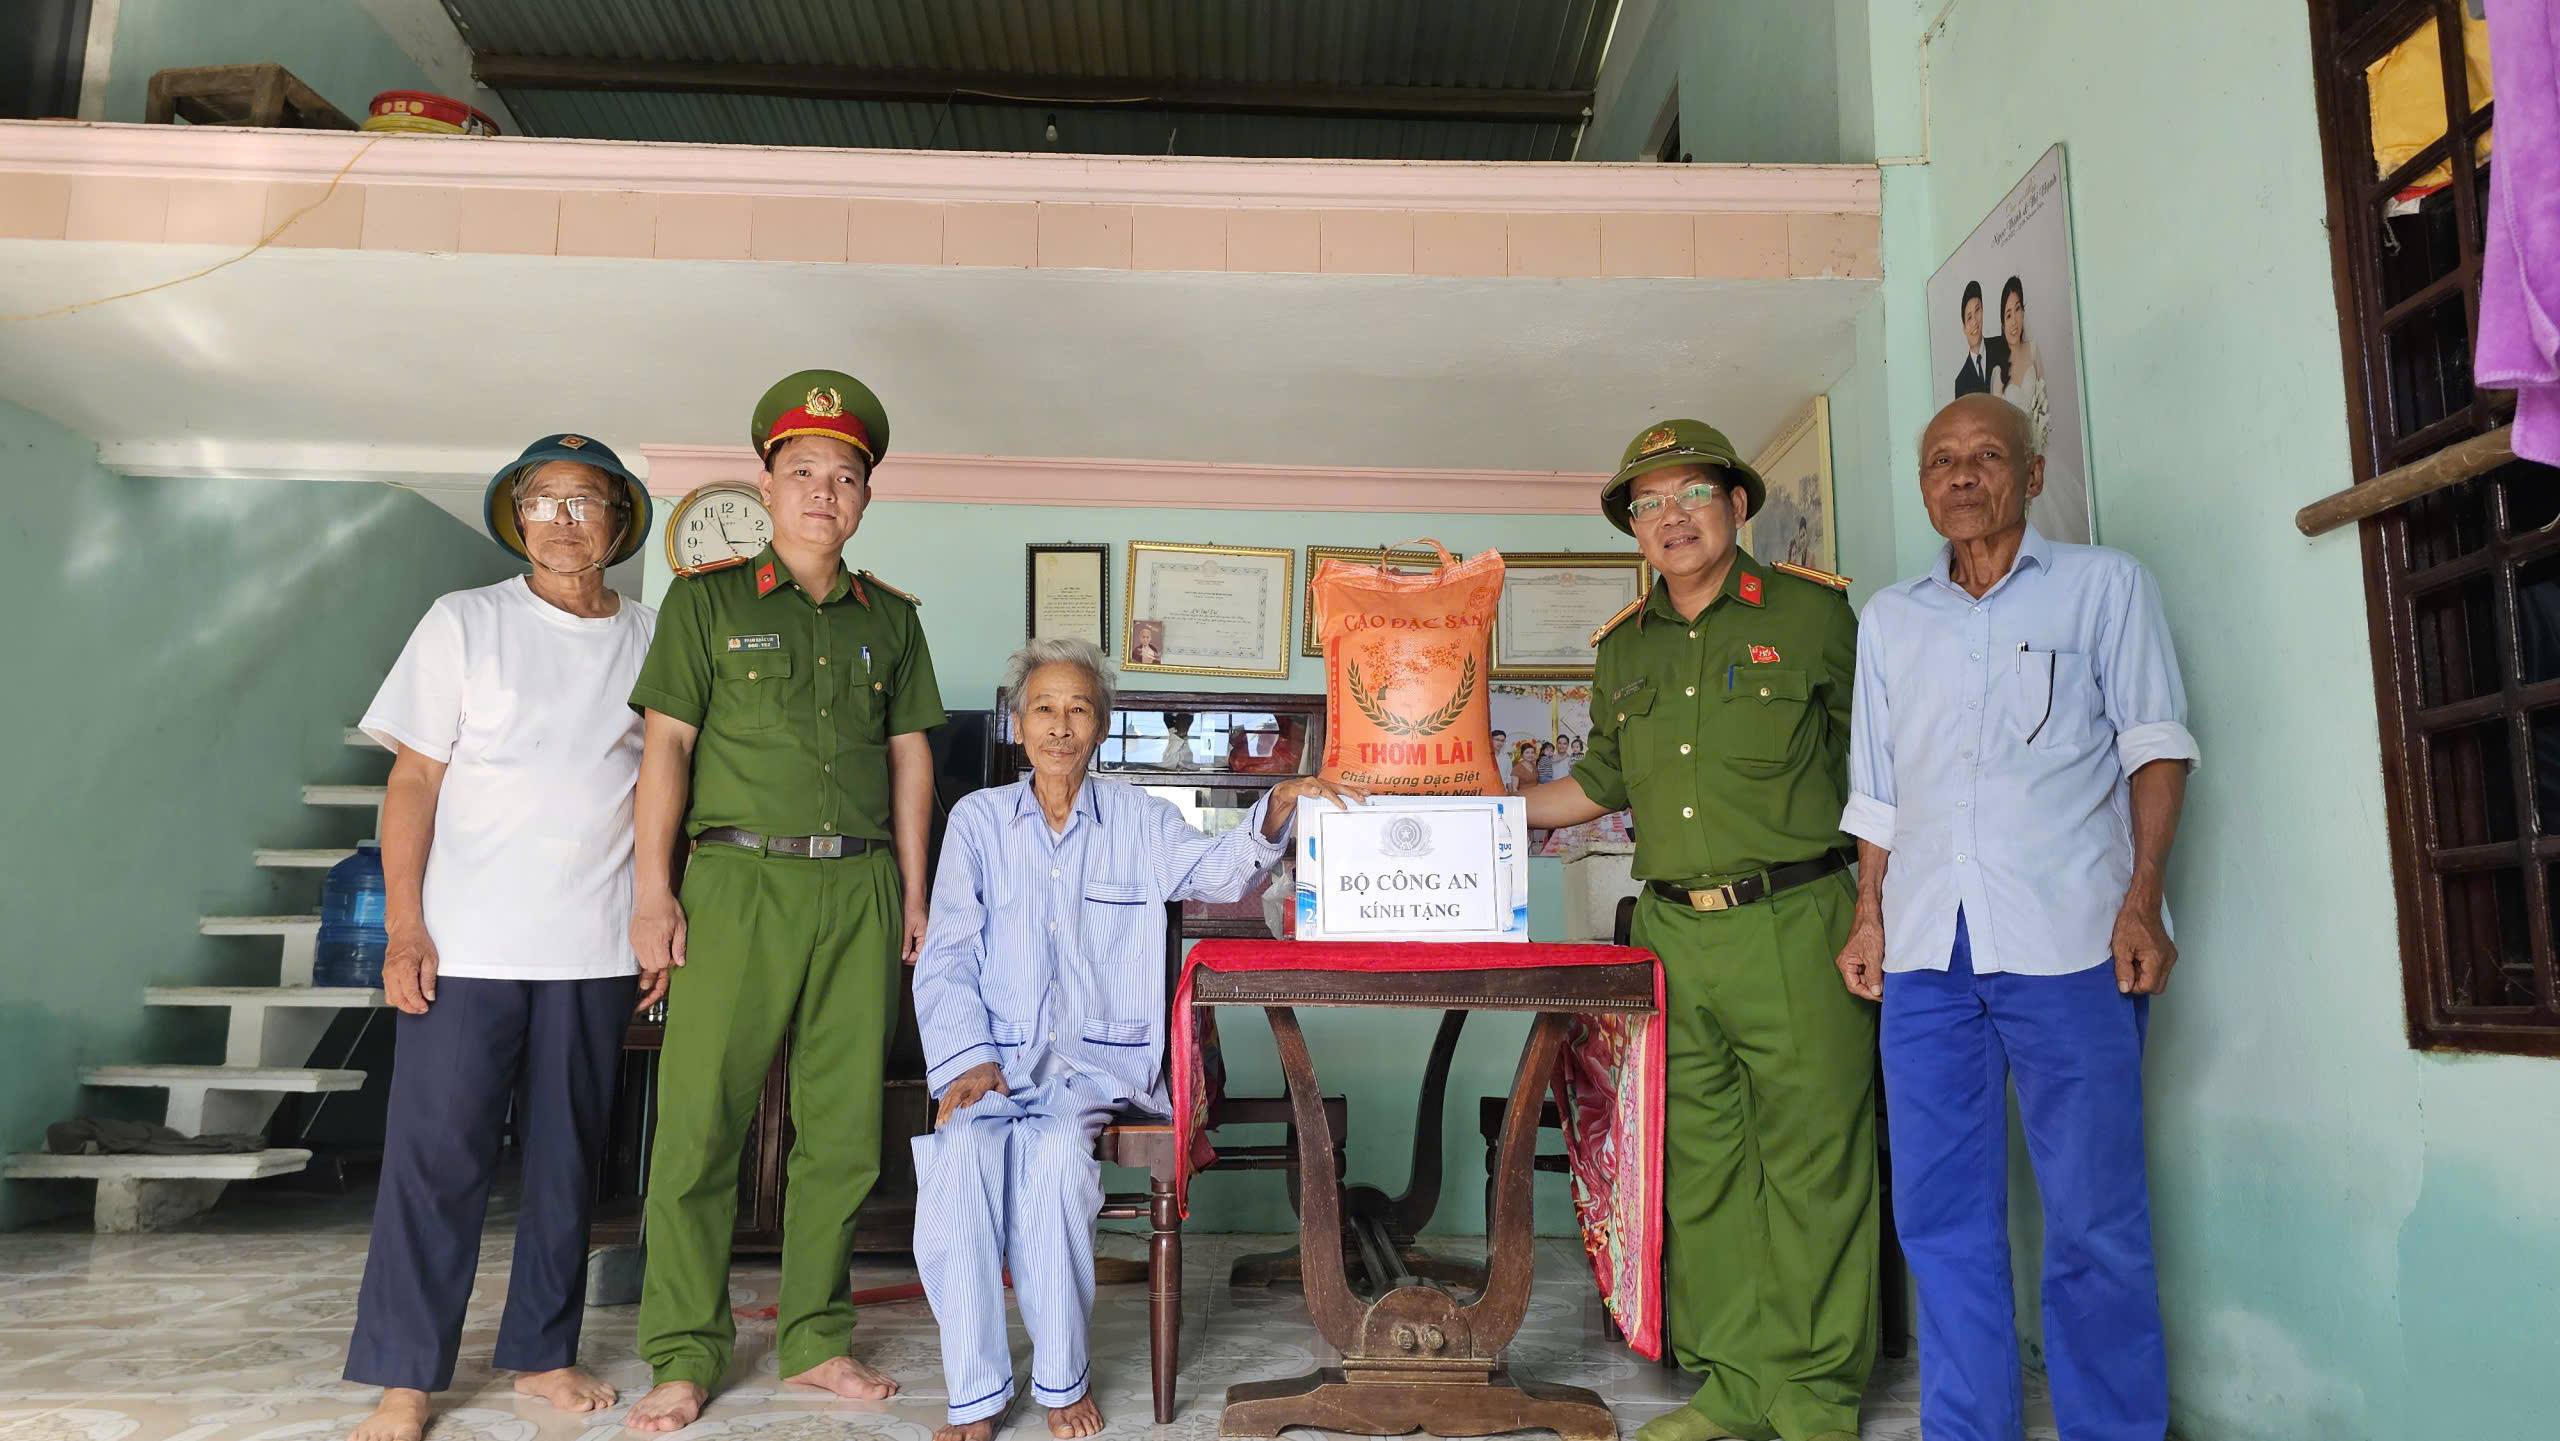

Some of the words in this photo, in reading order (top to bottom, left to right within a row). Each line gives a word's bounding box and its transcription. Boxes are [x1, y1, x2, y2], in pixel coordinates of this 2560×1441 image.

[704, 506, 714, 518] 11
[721, 502, 734, 513] 12
[743, 507, 748, 517] 1
[691, 520, 704, 531] 10
[755, 520, 764, 531] 2
[687, 537, 698, 548] 9
[758, 537, 768, 547] 3
[692, 554, 703, 565] 8
[1357, 741, 1427, 765] THƠM
[1435, 736, 1473, 765] LÀI
[1340, 770, 1371, 784] Chất
[1375, 774, 1419, 788] Lượng
[1423, 774, 1450, 788] Đặc
[1454, 770, 1480, 784] Biệt
[1339, 872, 1370, 895] BỘ
[1376, 869, 1441, 891] CÔNG
[1447, 873, 1478, 889] AN
[1359, 901, 1405, 919] KÍNH
[1410, 902, 1460, 920] TẶNG
